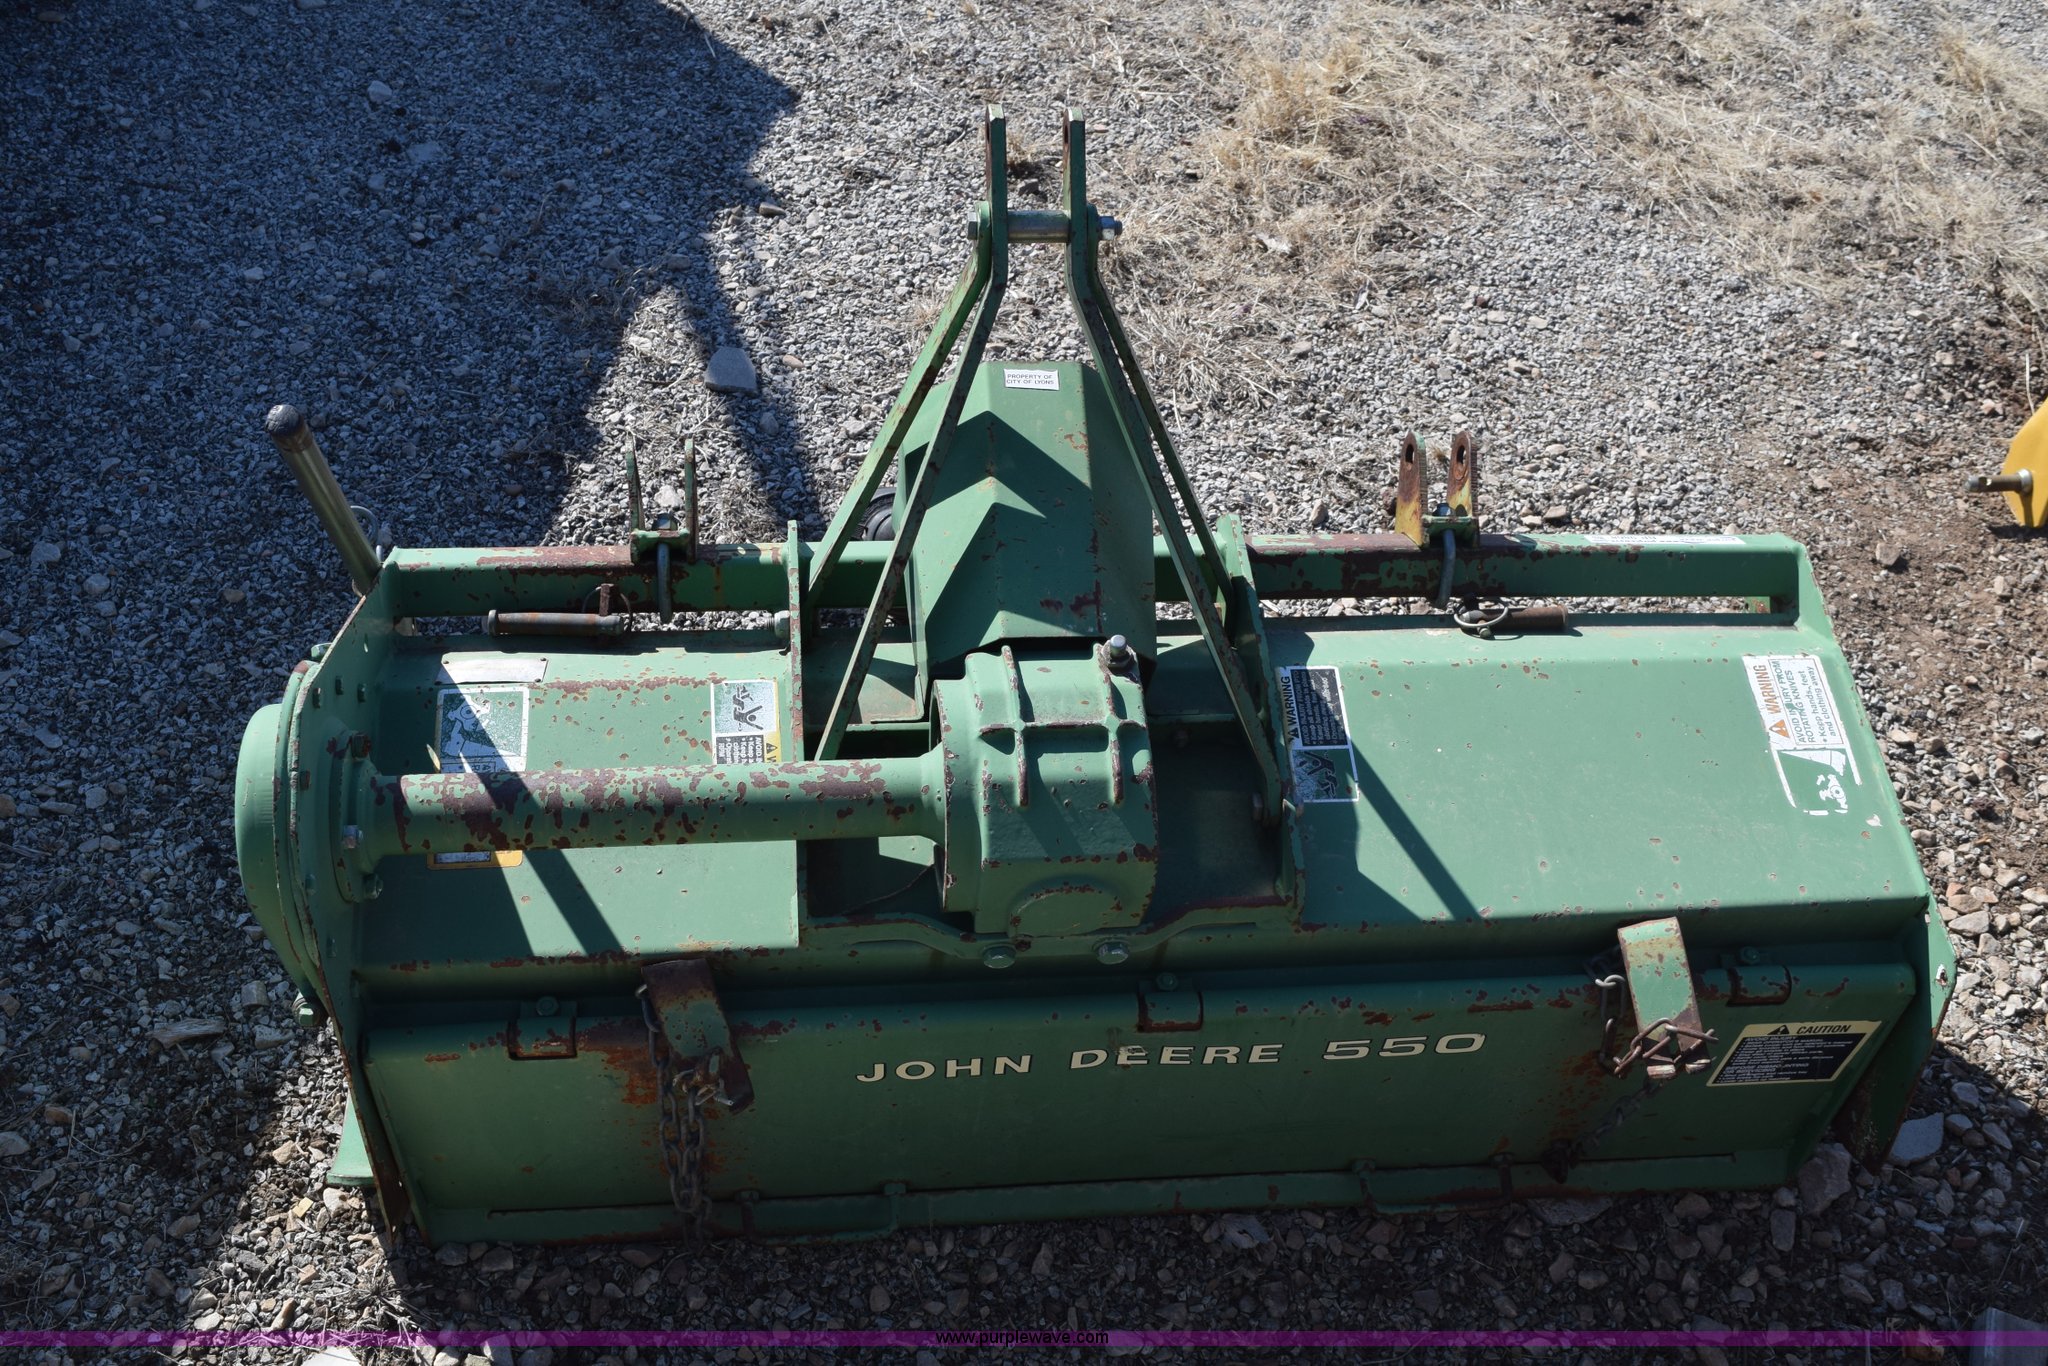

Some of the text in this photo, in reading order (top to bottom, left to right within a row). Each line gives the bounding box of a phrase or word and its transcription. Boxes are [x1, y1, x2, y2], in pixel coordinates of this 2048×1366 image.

[1281, 676, 1298, 726] WARNING
[1753, 664, 1782, 714] WARNING
[1772, 660, 1806, 742] AVOID INURY FROM
[1784, 670, 1800, 699] KNIVES
[1798, 670, 1809, 685] feet
[1808, 666, 1836, 736] and clothing away
[1815, 716, 1827, 736] Keep
[1796, 1025, 1851, 1034] CAUTION
[856, 1032, 1486, 1082] JOHN DEERE 550
